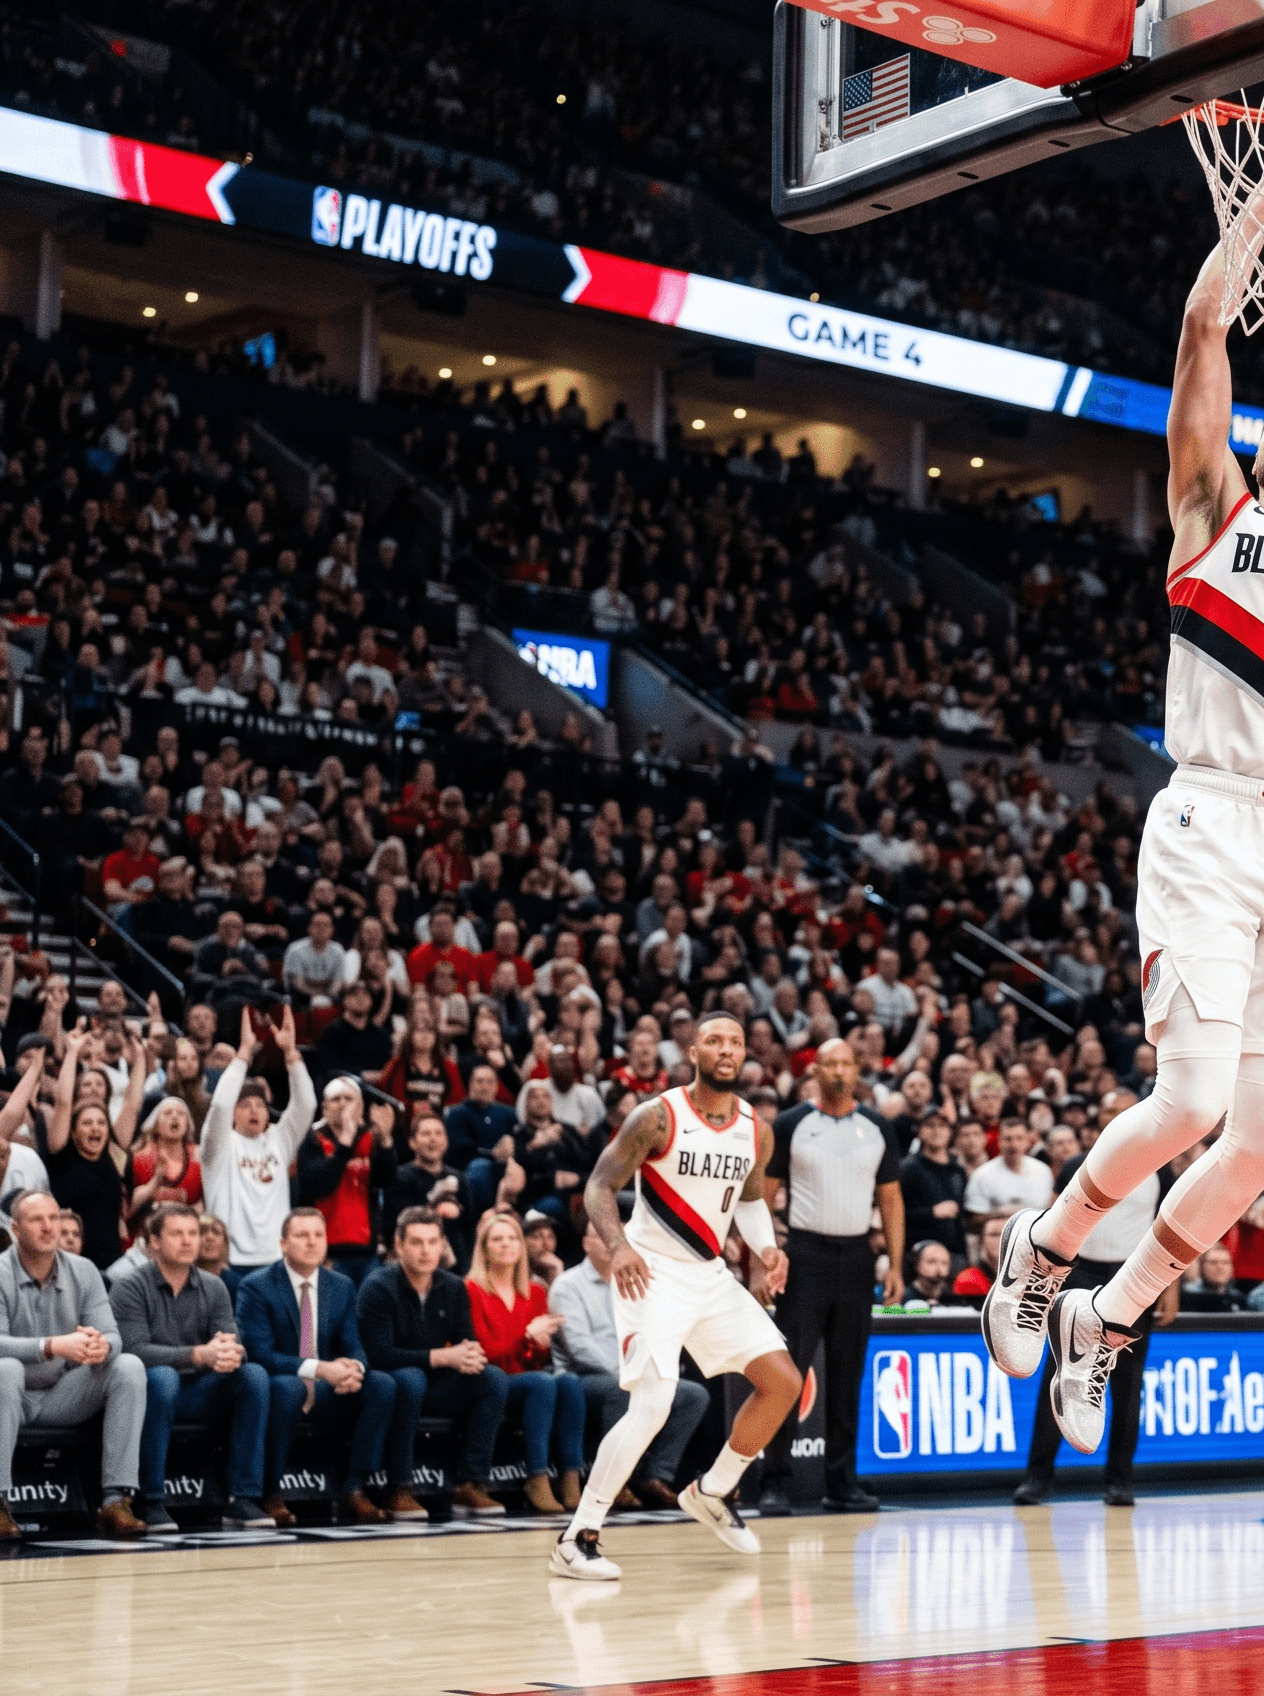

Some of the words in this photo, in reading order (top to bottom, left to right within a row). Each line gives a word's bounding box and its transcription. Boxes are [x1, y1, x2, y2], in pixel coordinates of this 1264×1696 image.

[340, 193, 498, 281] PLAYOFFS
[788, 314, 890, 361] GAME
[904, 342, 922, 367] 4
[678, 1150, 750, 1182] BLAZERS
[721, 1186, 735, 1213] 0
[918, 1352, 1017, 1455] NBA
